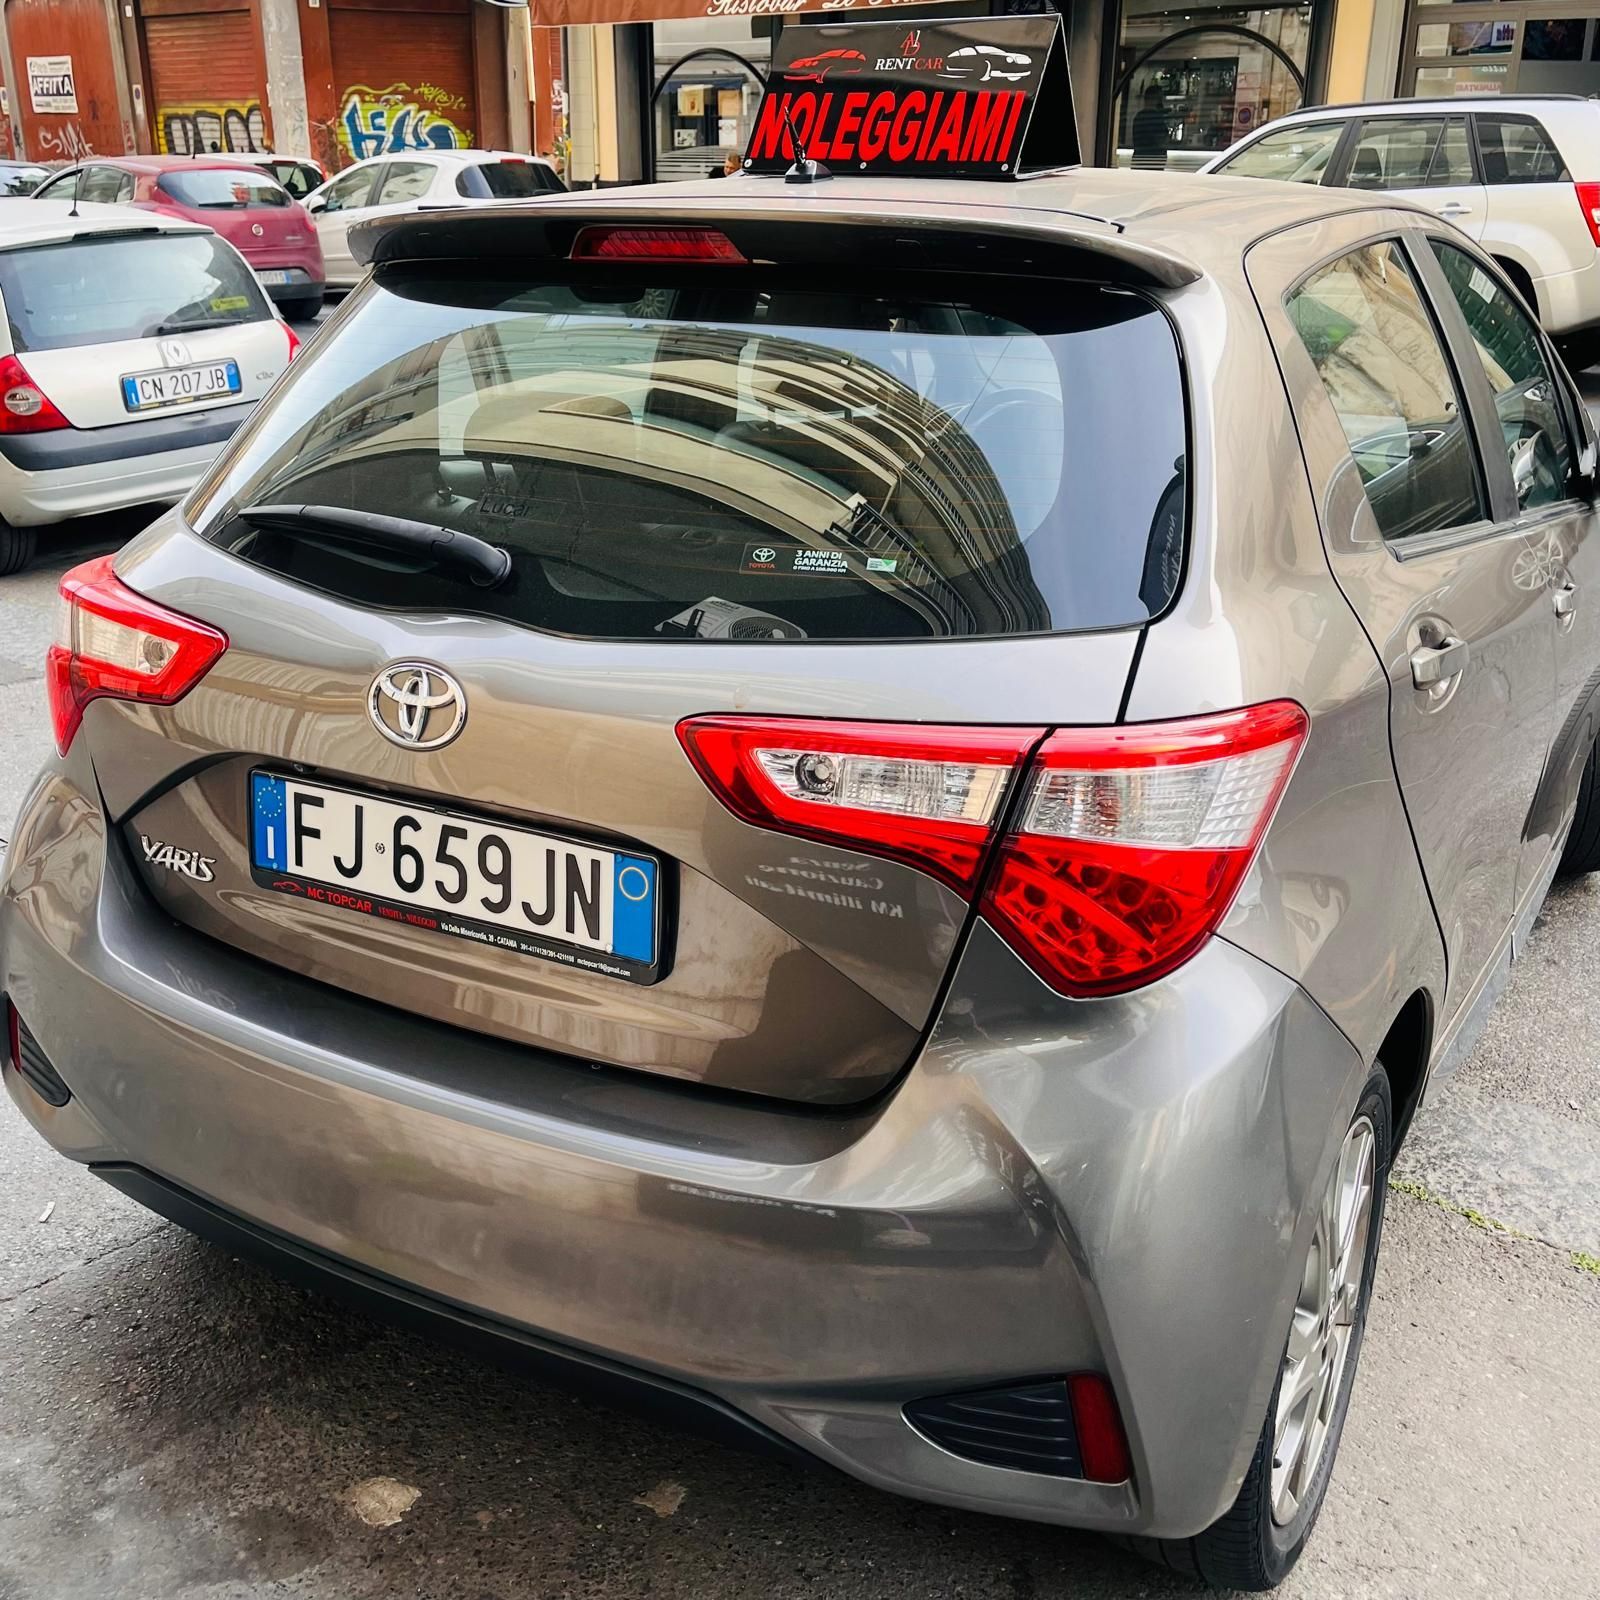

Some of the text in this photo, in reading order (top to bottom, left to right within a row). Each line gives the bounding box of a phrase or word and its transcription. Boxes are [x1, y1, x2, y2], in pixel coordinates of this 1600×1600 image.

[33, 75, 73, 96] AFFITTA
[751, 90, 1027, 163] NOLEGGIAMI
[140, 377, 164, 400] CN
[170, 371, 201, 396] 207
[206, 368, 226, 391] JB
[794, 557, 849, 569] GARANZIA
[801, 550, 830, 559] ANNI
[830, 551, 843, 560] DI
[749, 562, 776, 570] TOYOTA
[306, 886, 373, 913] MC TOPCAR
